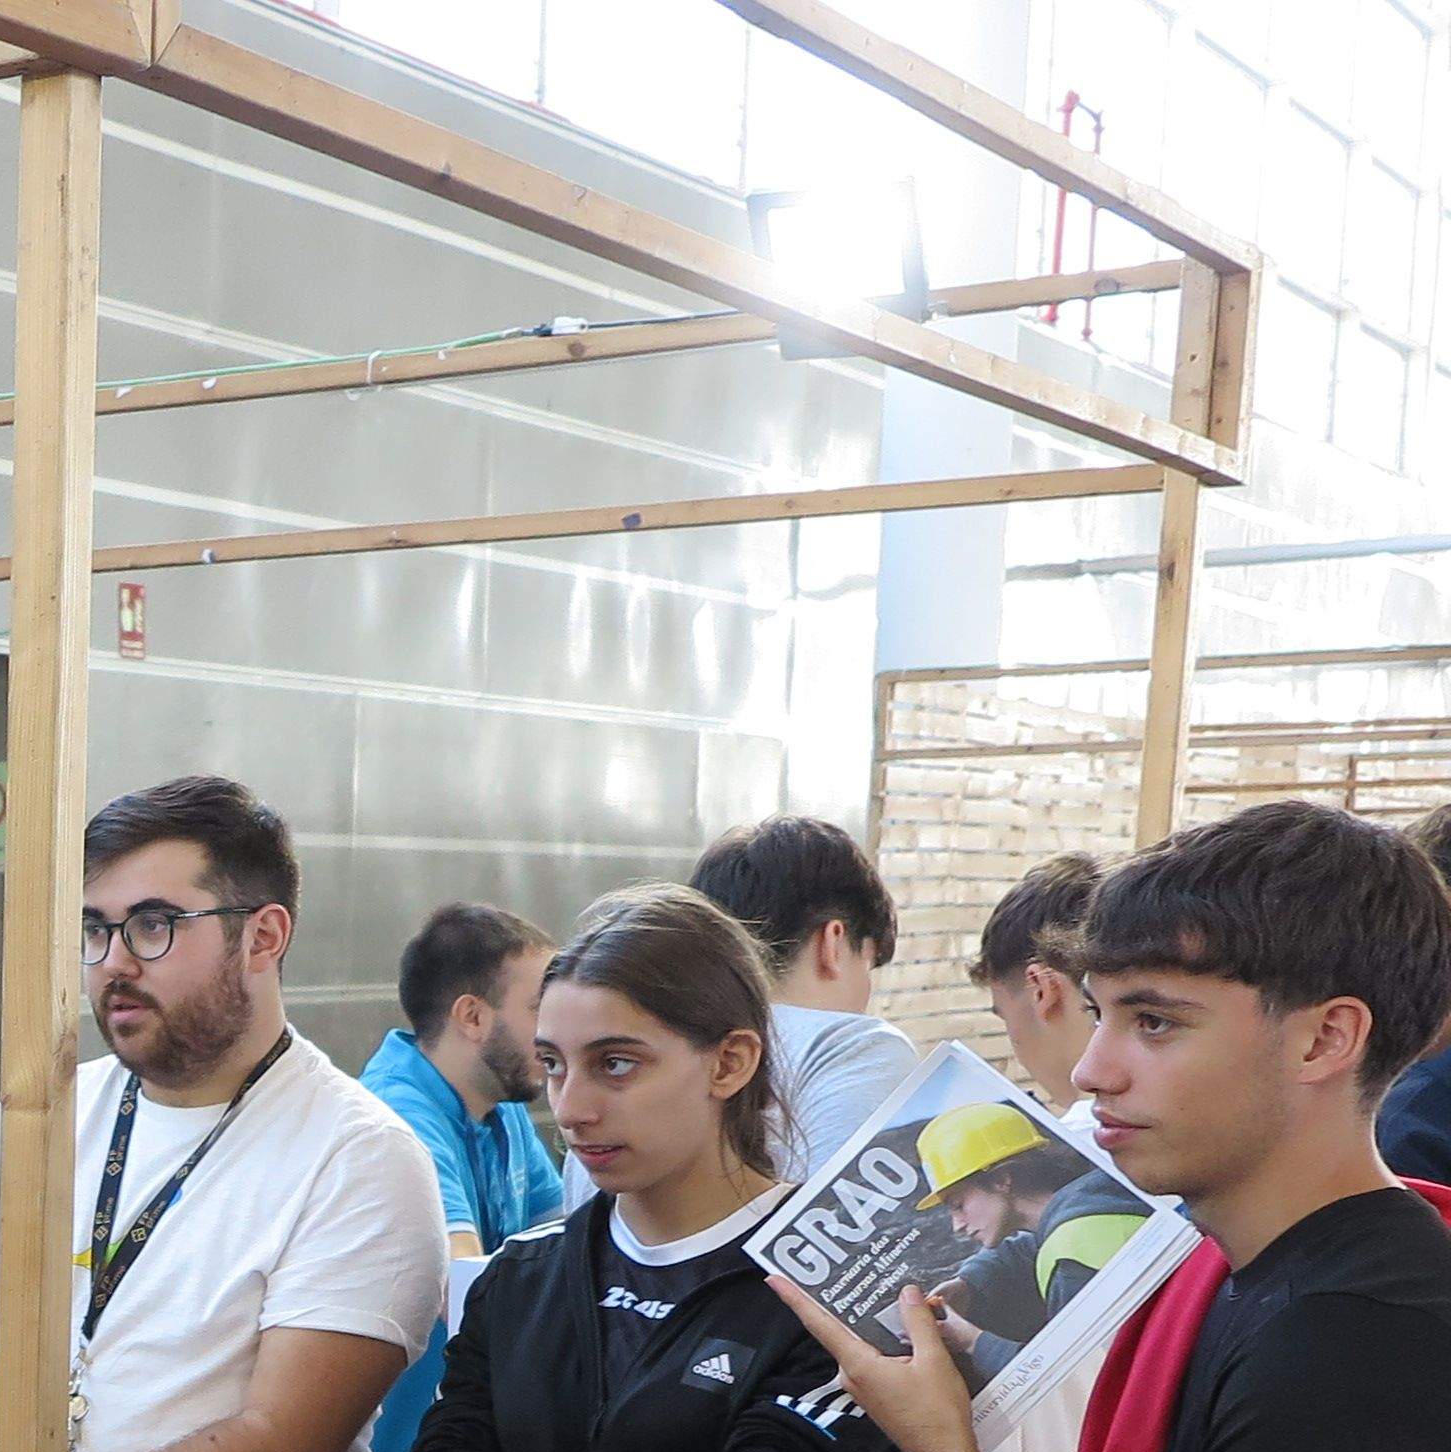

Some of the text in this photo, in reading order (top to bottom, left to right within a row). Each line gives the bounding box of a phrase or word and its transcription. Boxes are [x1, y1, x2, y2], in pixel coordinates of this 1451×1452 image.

[772, 1146, 919, 1286] GRAO
[870, 1235, 890, 1255] dos
[833, 1228, 921, 1314] Recursos Mineiros
